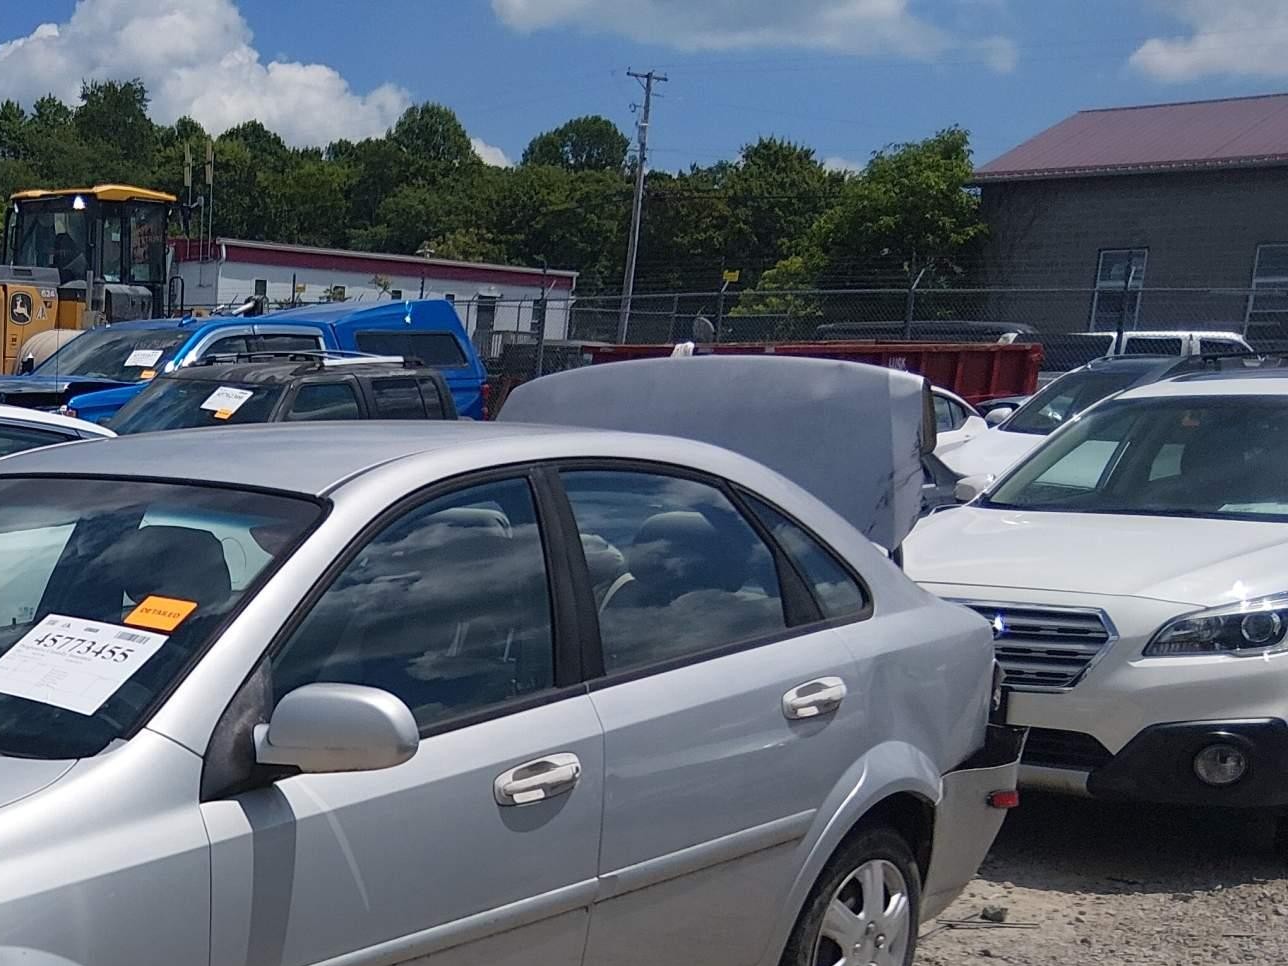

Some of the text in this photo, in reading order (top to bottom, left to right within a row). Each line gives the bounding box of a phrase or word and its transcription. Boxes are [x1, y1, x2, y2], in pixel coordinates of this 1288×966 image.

[40, 289, 56, 298] 624
[139, 607, 181, 619] DETAILED
[32, 632, 136, 663] 45773455
